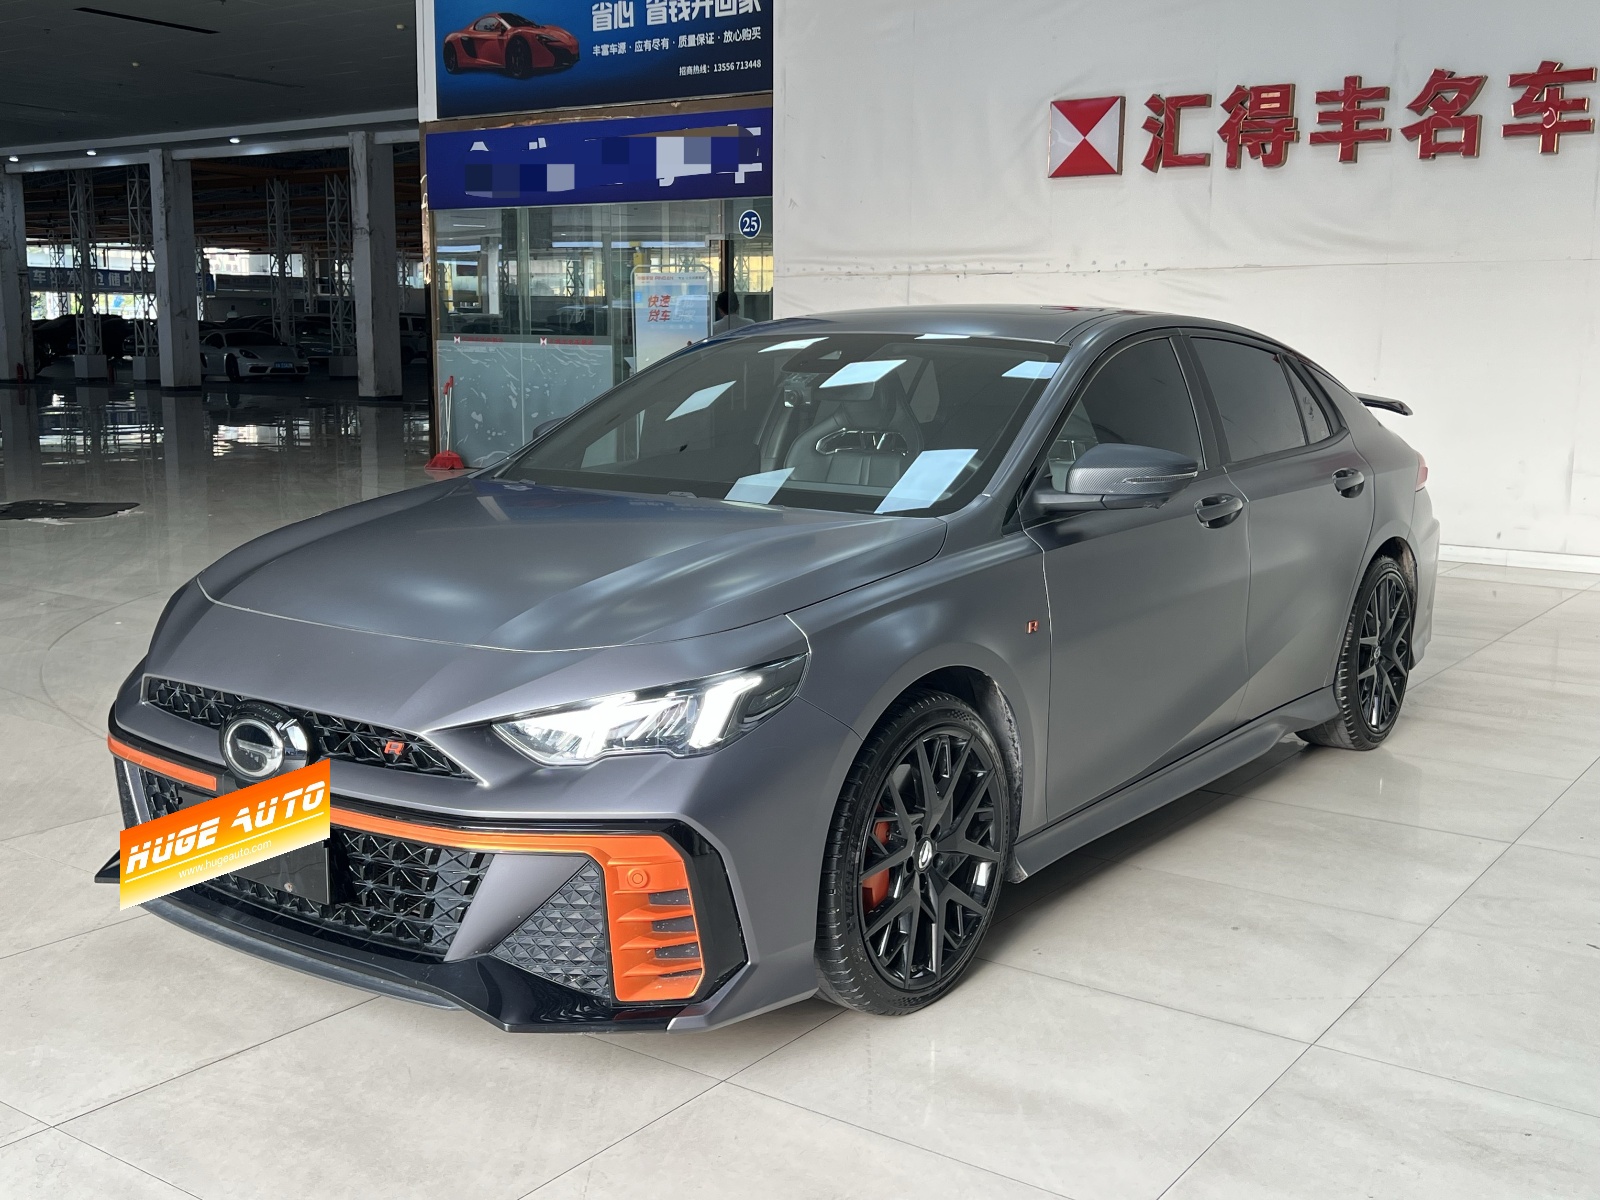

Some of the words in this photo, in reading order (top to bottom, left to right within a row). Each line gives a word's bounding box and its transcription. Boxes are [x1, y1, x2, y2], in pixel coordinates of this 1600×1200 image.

[592, 1, 635, 32] 省心
[592, 42, 627, 57] 丰富车源
[634, 38, 670, 52] 应有尽有
[678, 32, 715, 48] 质量保证
[723, 26, 762, 43] 放心购买
[1140, 60, 1598, 174] 汇得丰名车
[742, 217, 758, 232] 25
